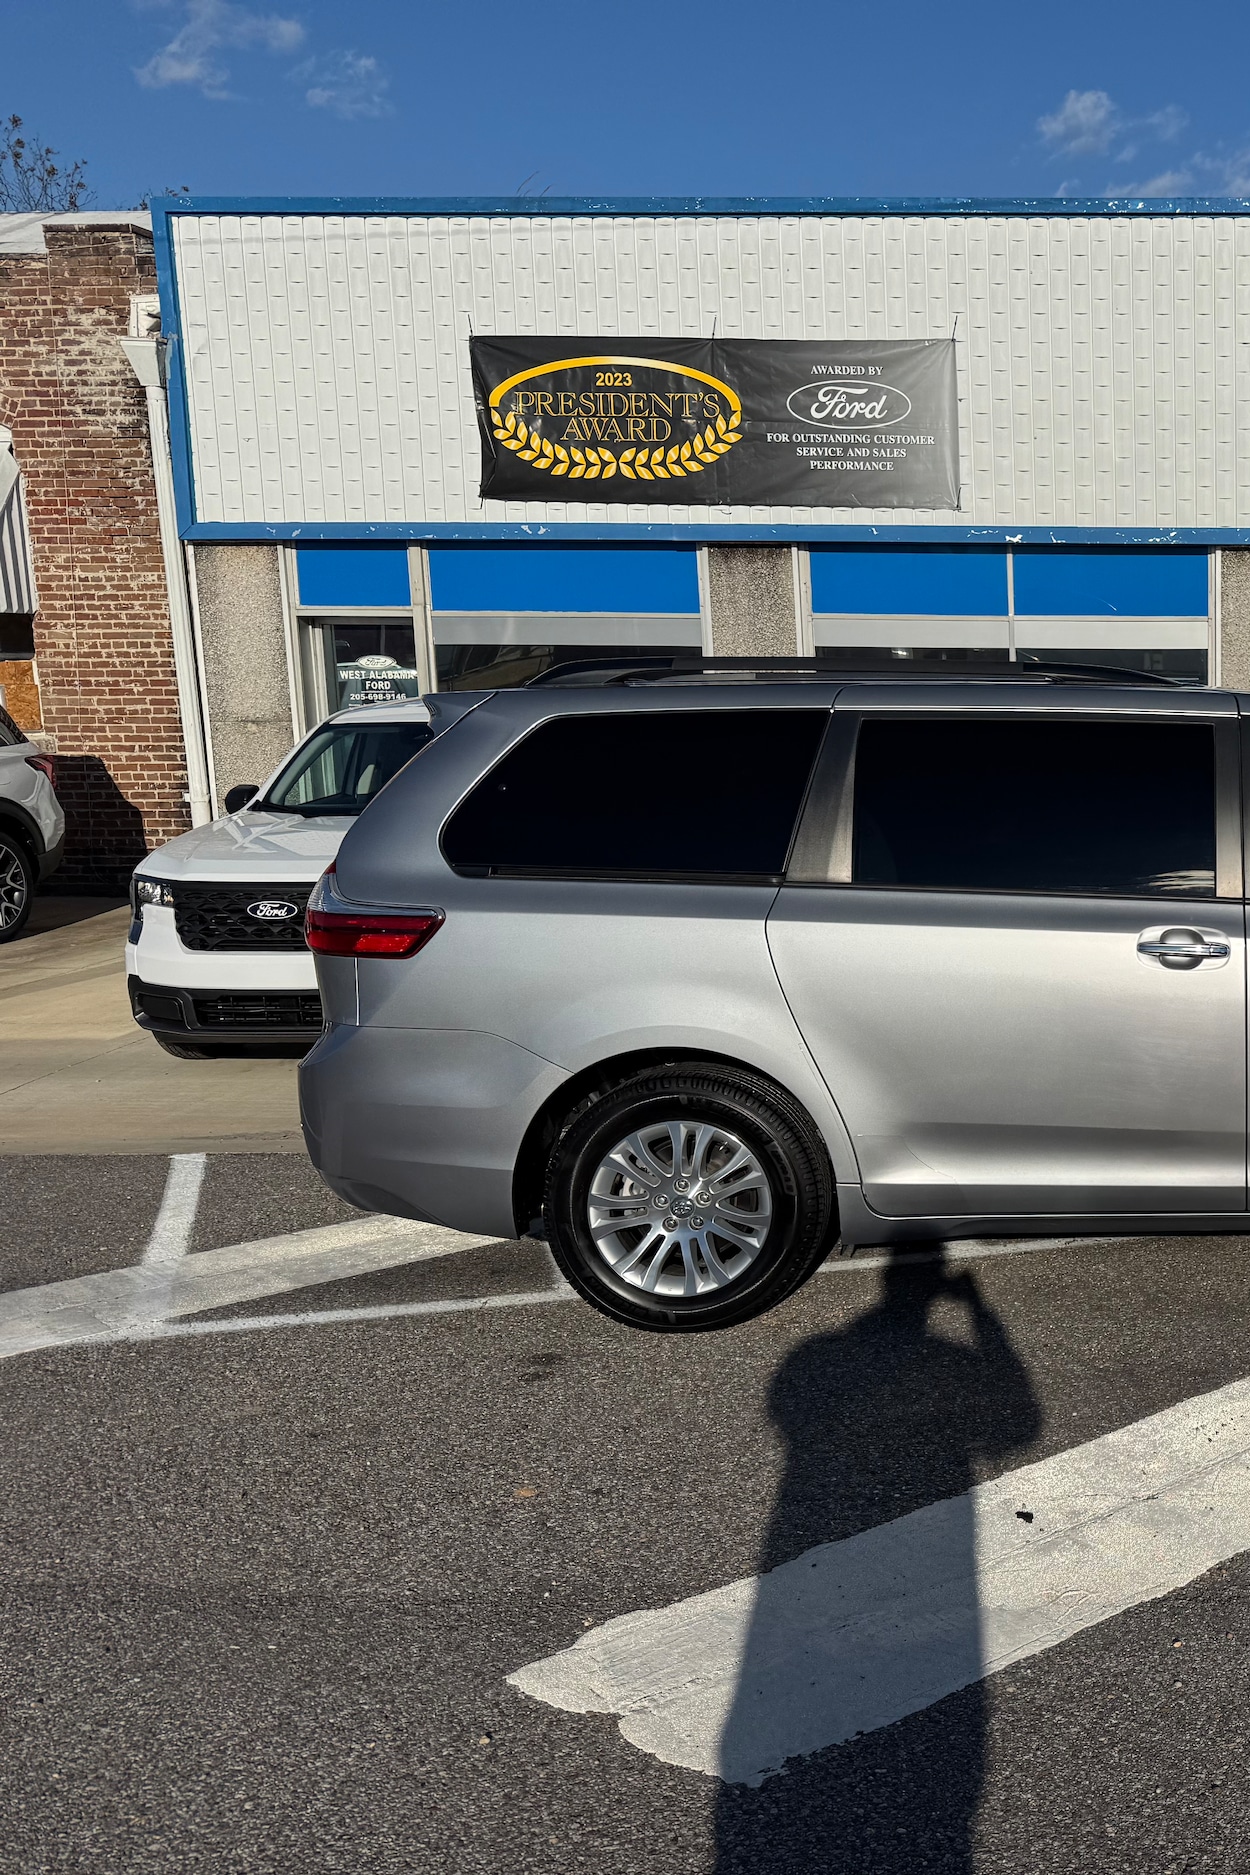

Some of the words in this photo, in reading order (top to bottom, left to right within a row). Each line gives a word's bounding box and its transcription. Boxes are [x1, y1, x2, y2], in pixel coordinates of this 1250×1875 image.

[811, 365, 865, 376] AWARDED
[868, 366, 883, 376] BY
[595, 372, 633, 387] 2023
[514, 391, 721, 419] PRESIDENT'S
[810, 386, 888, 419] Ford
[560, 416, 672, 443] AWARD
[766, 433, 790, 443] FOR
[792, 433, 871, 444] OUTSTANDING
[874, 434, 936, 445] CUSTOMER
[796, 447, 844, 457] SERVICE
[847, 447, 870, 458] AND
[872, 448, 907, 459] SALES
[809, 460, 895, 471] PERFORMANCE
[340, 670, 366, 680] WEST
[369, 670, 416, 680] ALABAMA
[365, 681, 391, 690] FORD
[256, 903, 288, 917] Ford
